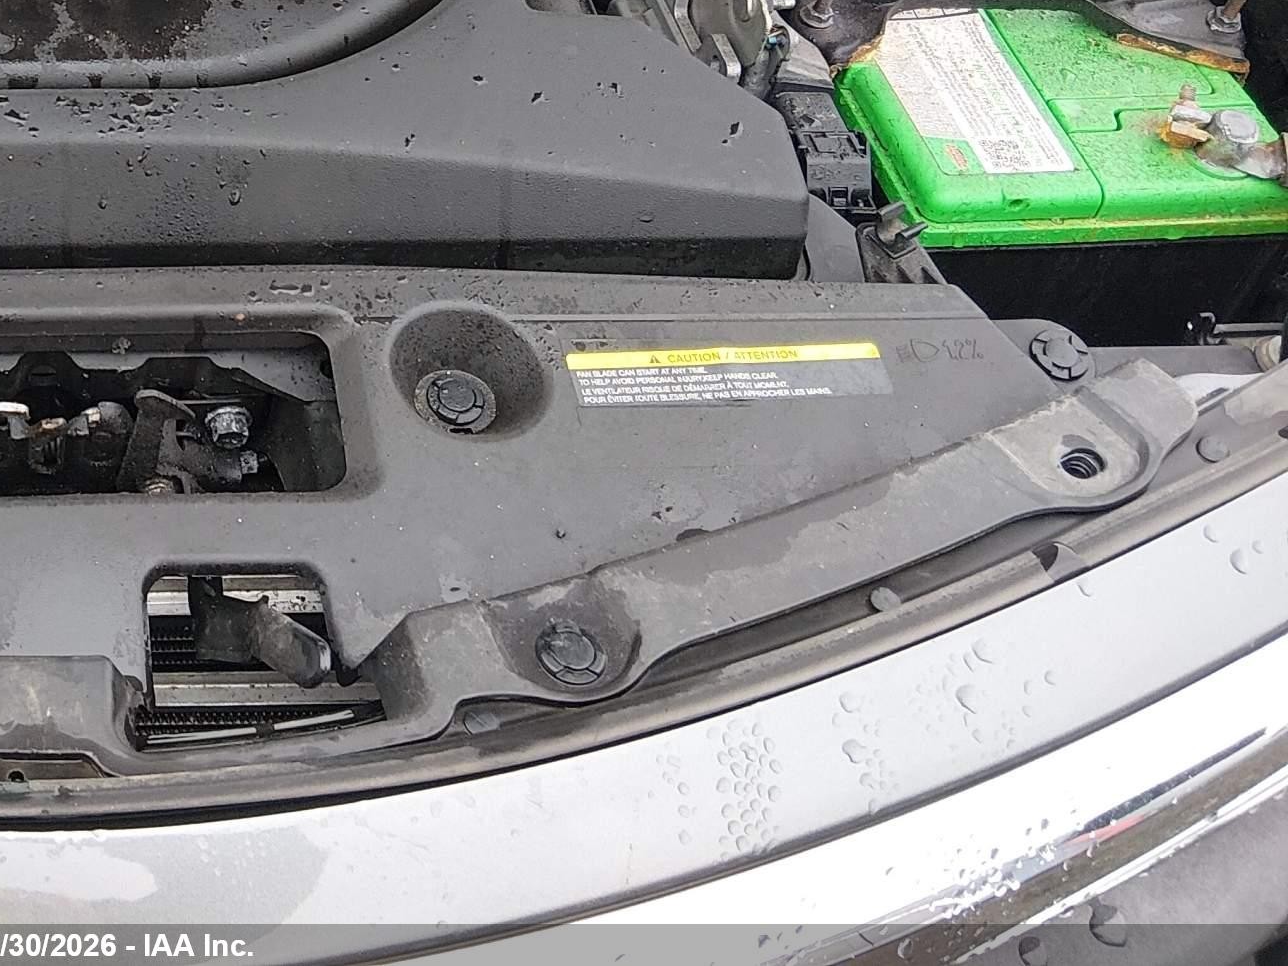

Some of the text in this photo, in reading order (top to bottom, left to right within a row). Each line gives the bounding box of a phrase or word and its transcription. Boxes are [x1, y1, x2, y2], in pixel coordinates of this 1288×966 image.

[667, 351, 721, 364] CAUTION
[734, 349, 798, 361] ATTENTION
[575, 370, 592, 379] FAN
[592, 369, 618, 378] BLADE
[617, 369, 636, 377] CAN
[635, 368, 660, 377] START
[660, 368, 672, 376] AT
[671, 367, 687, 375] ANY
[578, 378, 590, 386] TO
[590, 377, 611, 386] HELP
[611, 376, 635, 385] AVOID
[635, 375, 677, 384] PERSONAL
[723, 372, 752, 381] HANDS
[581, 388, 592, 396] LE
[591, 386, 642, 395] VENTILATEUR
[641, 385, 671, 393] RISQUE
[670, 384, 683, 392] DE
[732, 382, 753, 390] TOUT
[583, 395, 607, 403] POUR
[634, 393, 660, 401] TOUTE
[702, 391, 714, 399] NE
[713, 390, 731, 399] PAS
[730, 390, 743, 398] EN
[742, 388, 790, 398] APPROCHER
[790, 388, 806, 396] LES
